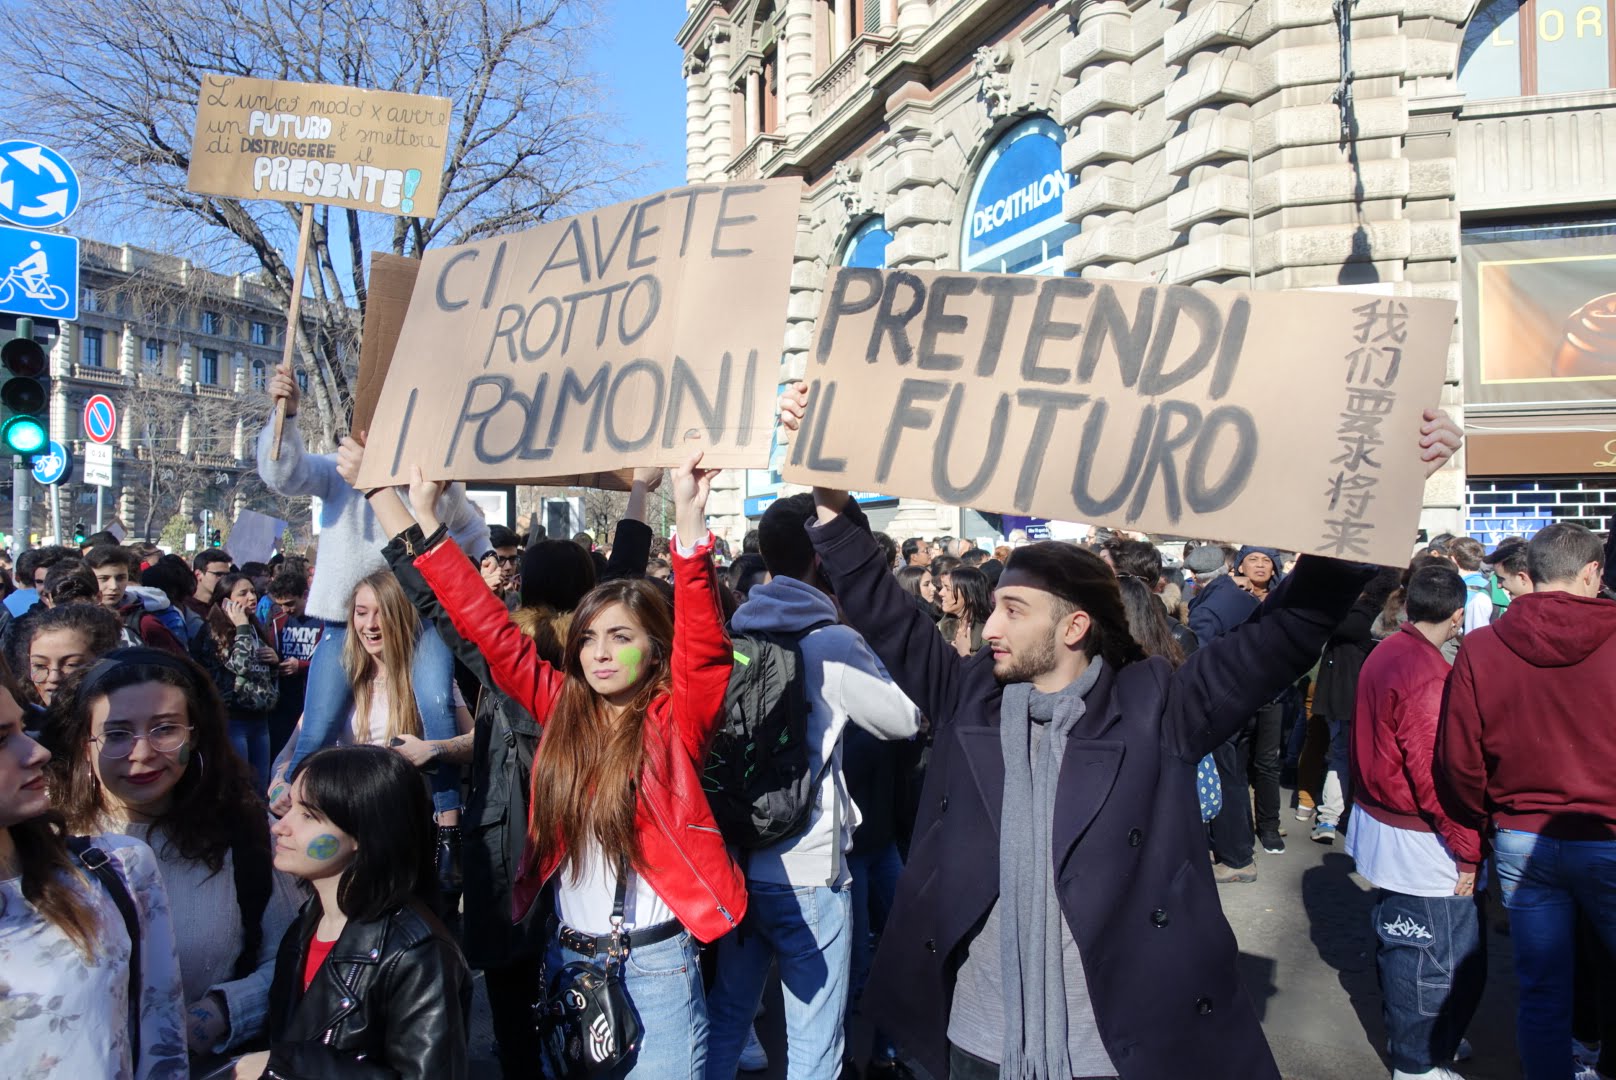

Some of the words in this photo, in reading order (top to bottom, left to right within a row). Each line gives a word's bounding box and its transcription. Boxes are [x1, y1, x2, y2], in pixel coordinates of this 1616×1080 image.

[205, 120, 242, 134] un
[248, 110, 332, 140] FUTURO
[356, 127, 441, 149] smettere
[205, 135, 233, 154] di
[241, 138, 336, 158] DISTRUGGERE
[354, 146, 374, 164] il
[207, 76, 300, 112] L'unico
[308, 96, 365, 118] modo
[387, 107, 449, 127] avere
[253, 156, 422, 214] PRESENTE!
[973, 169, 1070, 239] DECATHLON
[435, 241, 507, 313] CI
[528, 184, 767, 294] AVETE
[483, 273, 662, 369] ROTTO
[815, 266, 1253, 401] PRETENDI
[390, 387, 419, 478] I
[443, 347, 759, 468] POLMONI
[790, 378, 849, 473] IL
[874, 378, 1259, 526] FUTURO
[1314, 299, 1409, 557] 我们要求将来
